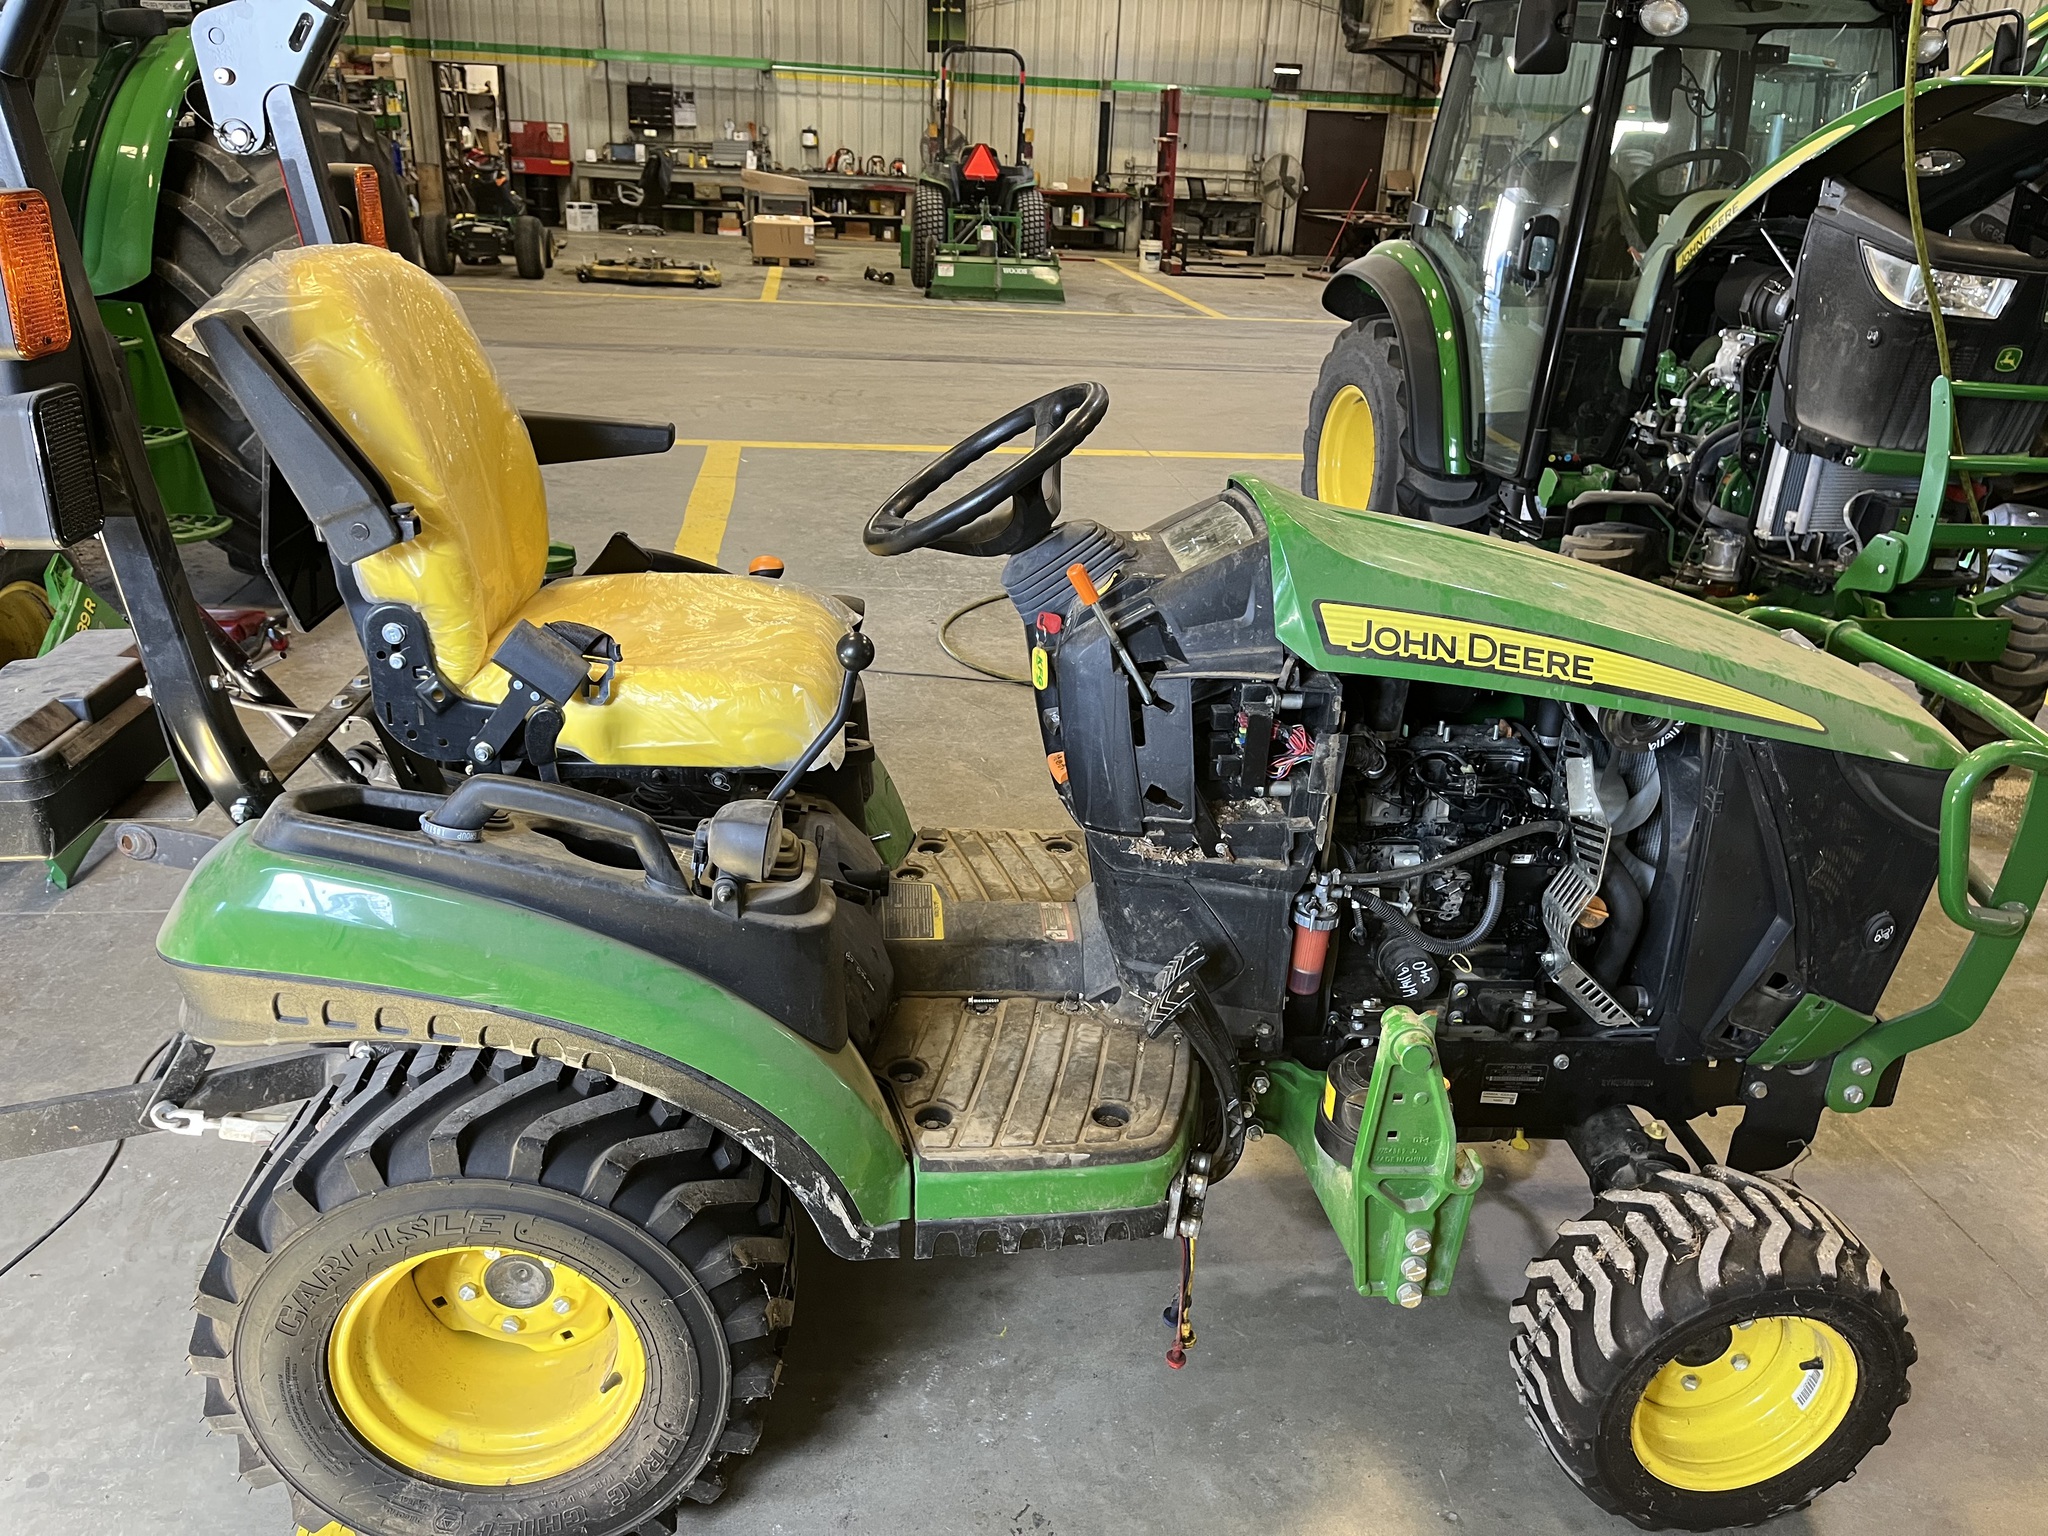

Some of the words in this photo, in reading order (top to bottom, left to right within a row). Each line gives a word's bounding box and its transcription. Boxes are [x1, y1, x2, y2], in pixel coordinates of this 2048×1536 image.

[1678, 236, 1704, 269] JOHN
[1704, 201, 1740, 241] DEERE
[1351, 619, 1457, 659] JOHN
[1468, 632, 1595, 681] DEERE
[273, 1213, 506, 1338] CARLISLE
[577, 1488, 589, 1499] IN
[590, 1473, 615, 1492] MADE
[606, 1433, 678, 1507] TRAC
